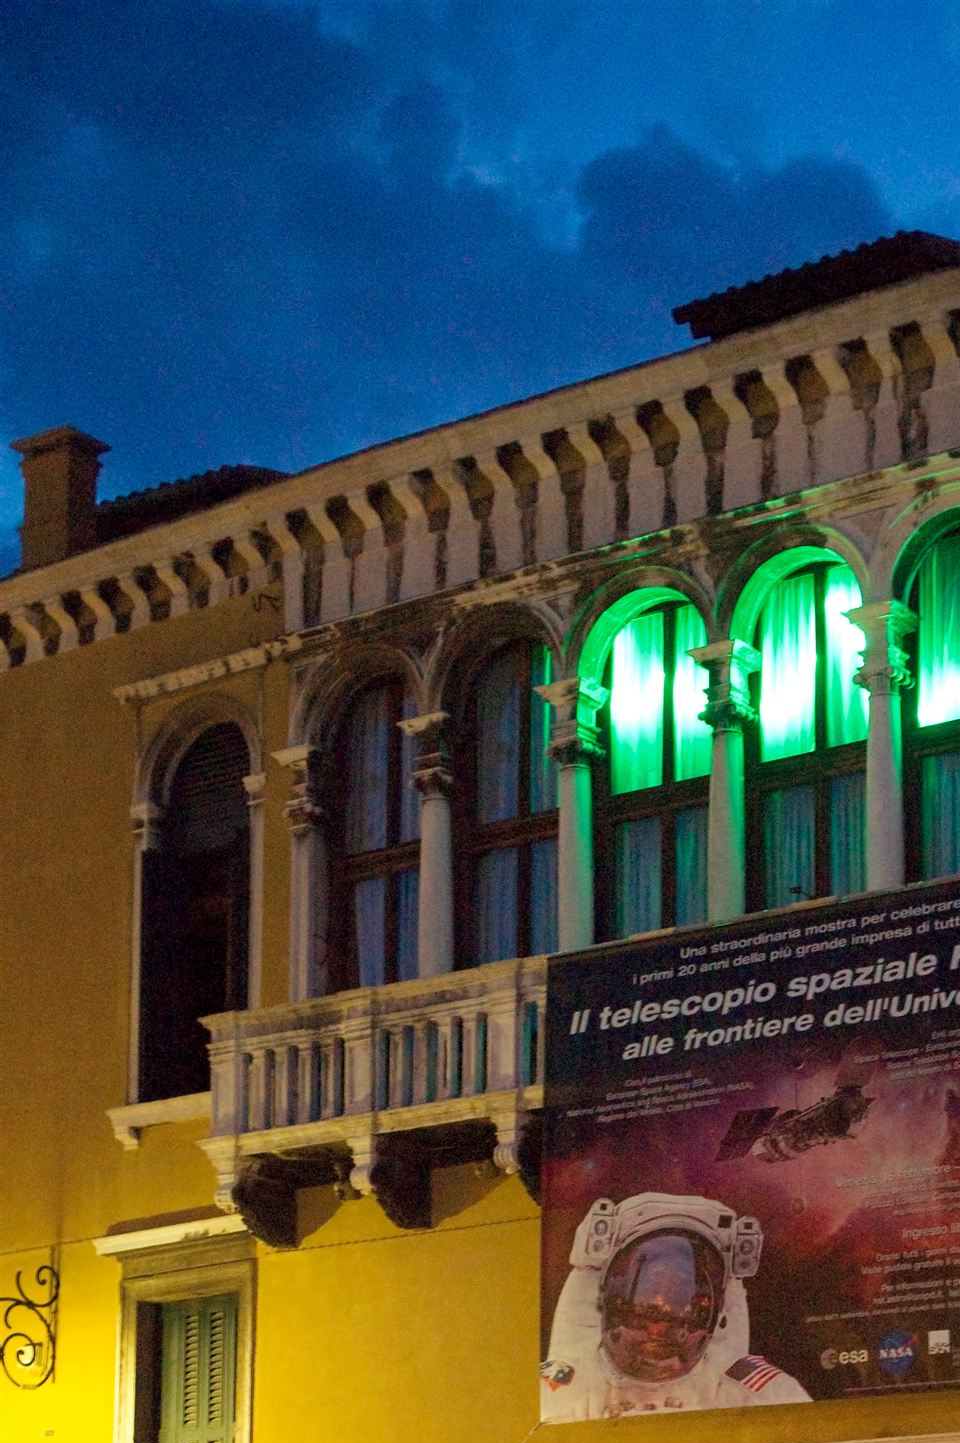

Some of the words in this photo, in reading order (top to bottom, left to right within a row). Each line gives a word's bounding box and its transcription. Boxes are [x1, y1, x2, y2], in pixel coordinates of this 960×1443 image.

[633, 971, 638, 985] i
[640, 966, 674, 986] primi
[677, 964, 697, 978] 20
[700, 957, 730, 973] anni
[733, 950, 766, 967] della
[770, 945, 792, 963] più
[795, 934, 847, 958] grande
[852, 927, 913, 947] impresa
[917, 920, 931, 935] di
[680, 945, 707, 960] Una
[711, 928, 801, 953] straordinaria
[805, 916, 856, 936] mostra
[861, 913, 886, 929] per
[569, 1008, 592, 1035] Il
[600, 979, 776, 1031] telescopio
[786, 952, 938, 1000] spaziale
[622, 1031, 675, 1061] alle
[684, 1008, 815, 1052] frontiere
[902, 1225, 949, 1241] Ingresso
[879, 1346, 914, 1360] NASA
